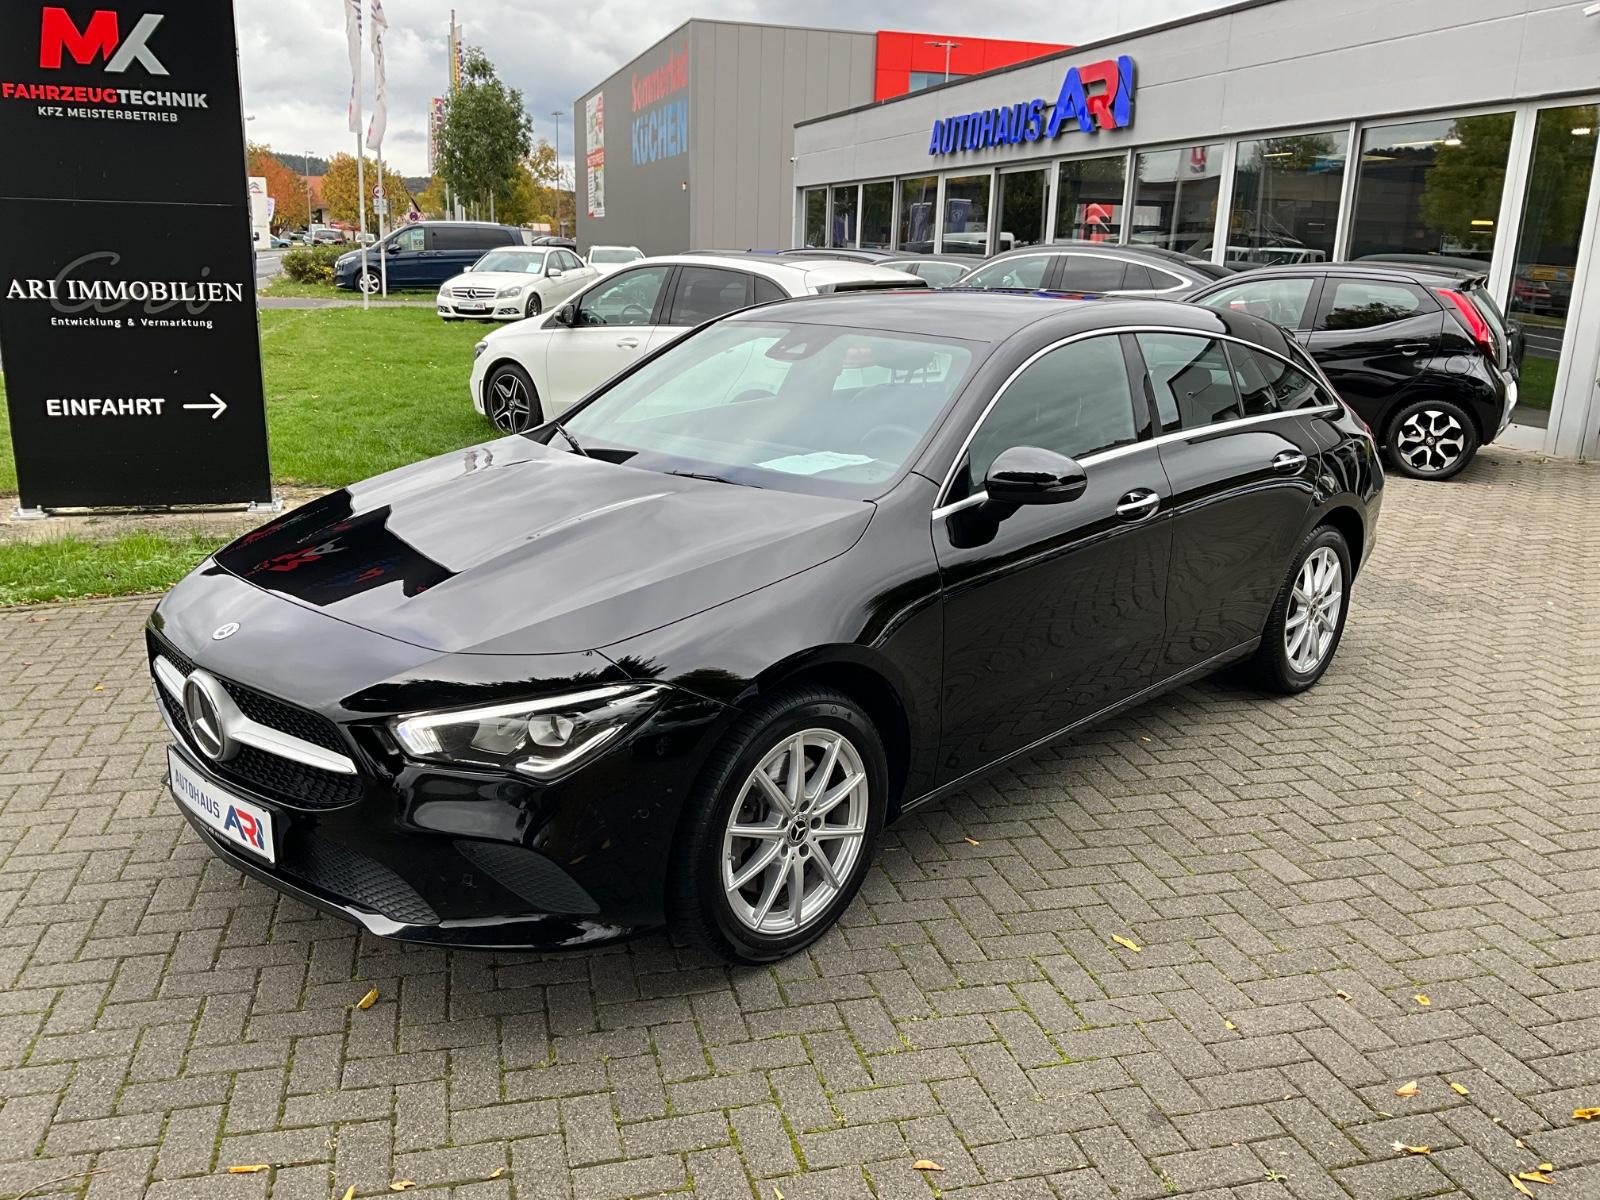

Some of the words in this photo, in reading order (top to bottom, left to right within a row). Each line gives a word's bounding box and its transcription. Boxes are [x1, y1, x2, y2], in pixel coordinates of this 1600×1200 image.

[40, 7, 170, 76] MK
[2, 82, 208, 109] FAHRZEUGTECHNIK
[928, 99, 1046, 155] AUTOHAUS
[1046, 54, 1136, 139] ARI
[38, 106, 64, 117] KFZ
[67, 108, 178, 122] MEISTERBETRIEB
[6, 279, 58, 299] ARI
[68, 280, 243, 302] IMMOBILIEN
[51, 317, 121, 328] Entwicklung
[127, 318, 135, 327] &
[141, 318, 213, 329] Vermarktung
[46, 398, 165, 416] EINFAHRT
[175, 769, 220, 819] AUTOHAUS
[224, 804, 265, 850] ARI
